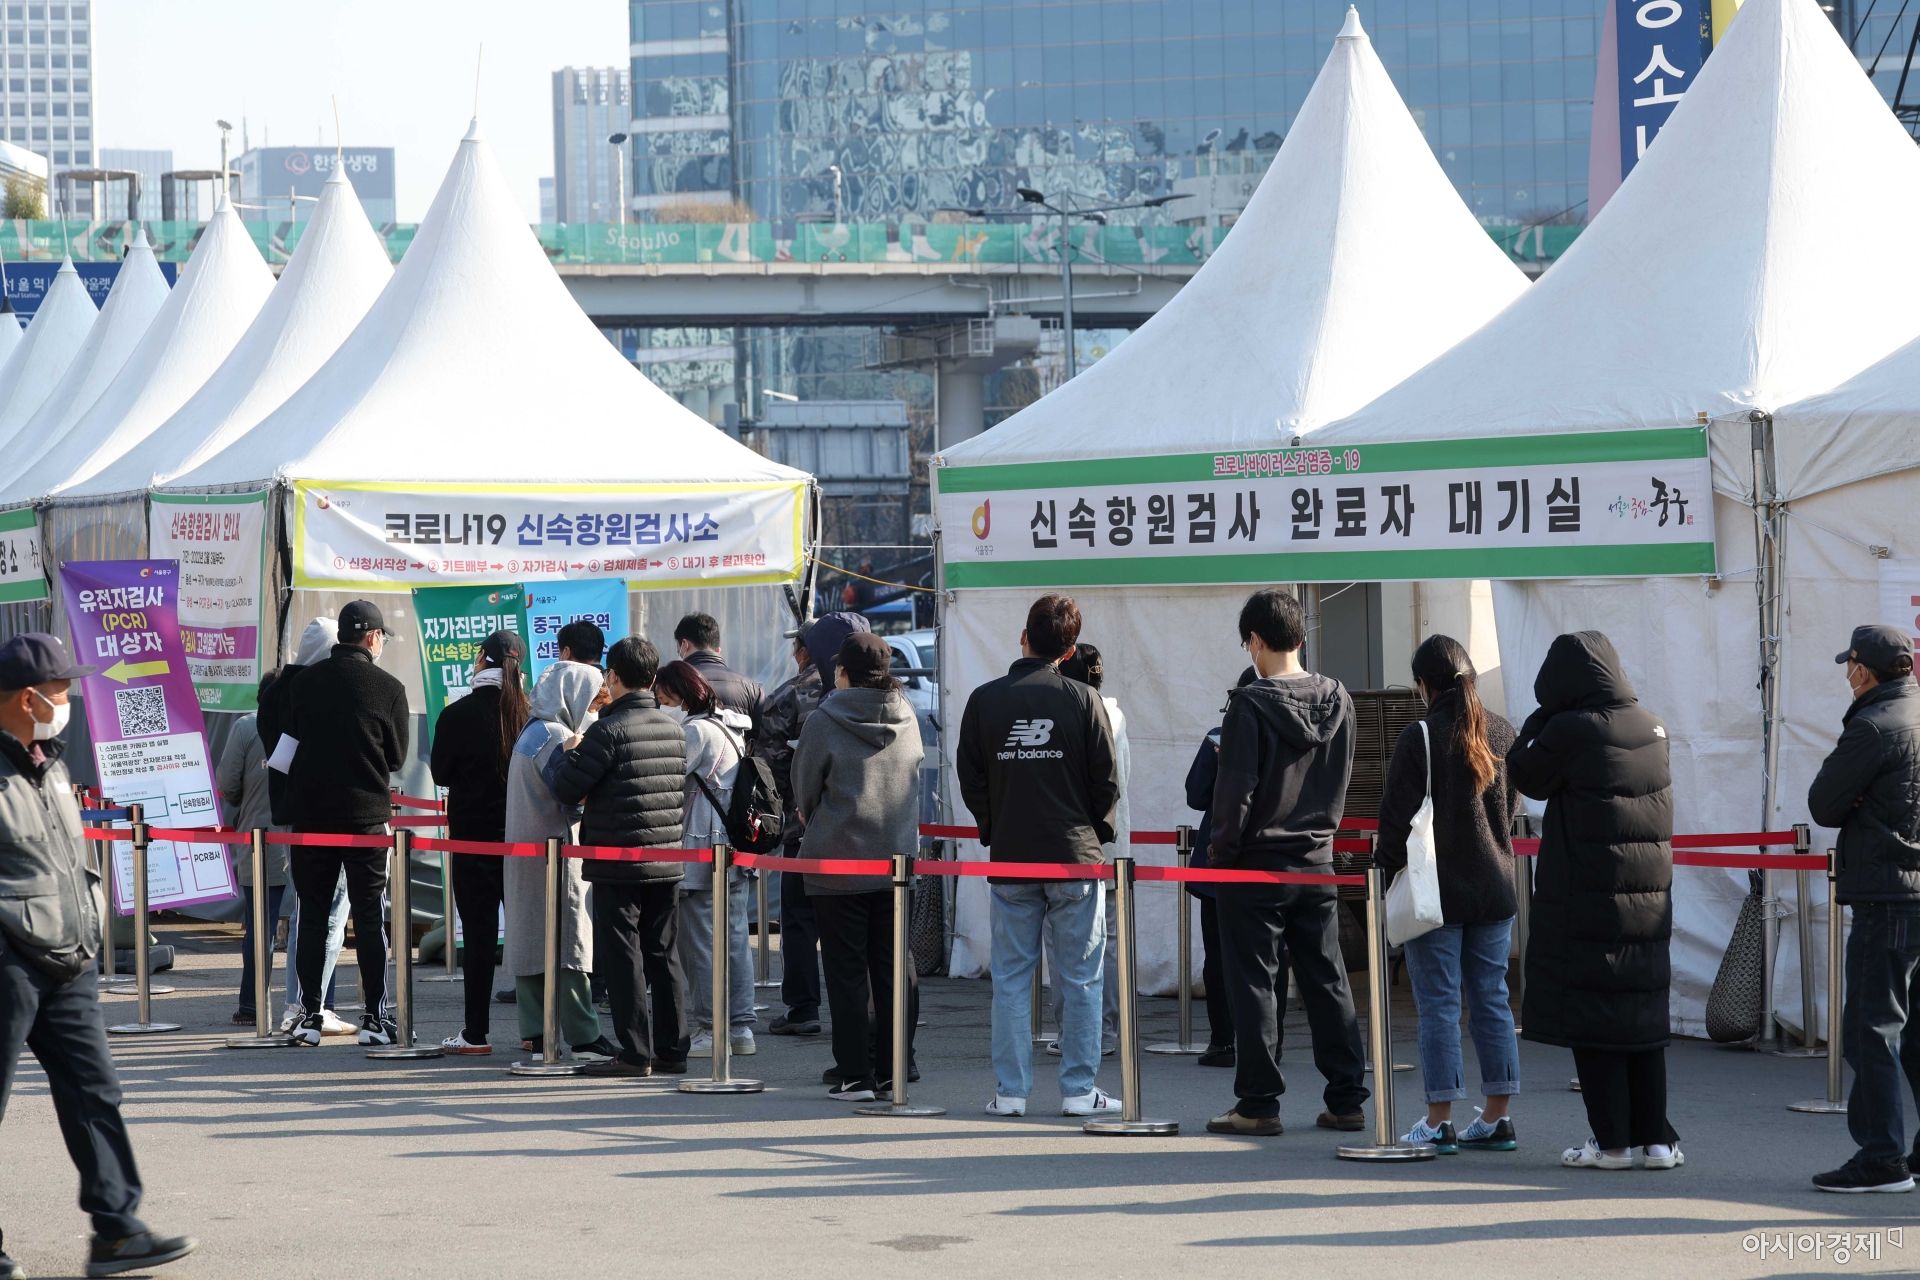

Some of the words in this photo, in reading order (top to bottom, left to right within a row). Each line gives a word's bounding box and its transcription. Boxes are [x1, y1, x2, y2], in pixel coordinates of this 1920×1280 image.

[1031, 490, 1260, 549] 신속항원검사
[1291, 484, 1414, 540] 완료자
[1449, 477, 1581, 534] 대기실
[172, 512, 220, 541] 신속항원검사
[385, 513, 506, 545] 코로나19
[517, 513, 720, 546] 신속항원검사소
[349, 557, 407, 571] 신청서작성
[442, 560, 488, 573] 키트배부
[522, 560, 568, 573] 자가검사
[603, 558, 648, 572] 검체제출
[683, 556, 705, 569] 대기
[709, 555, 719, 568] 후
[723, 553, 766, 567] 결과확인
[79, 586, 164, 613] 유전자검사
[102, 611, 148, 632] (PCR)
[424, 615, 519, 639] 자가진단키트
[533, 615, 561, 634] 중구
[95, 632, 163, 658] 대상자
[997, 751, 1016, 760] new
[1017, 749, 1063, 760] balance
[194, 851, 220, 862] PCR검사
